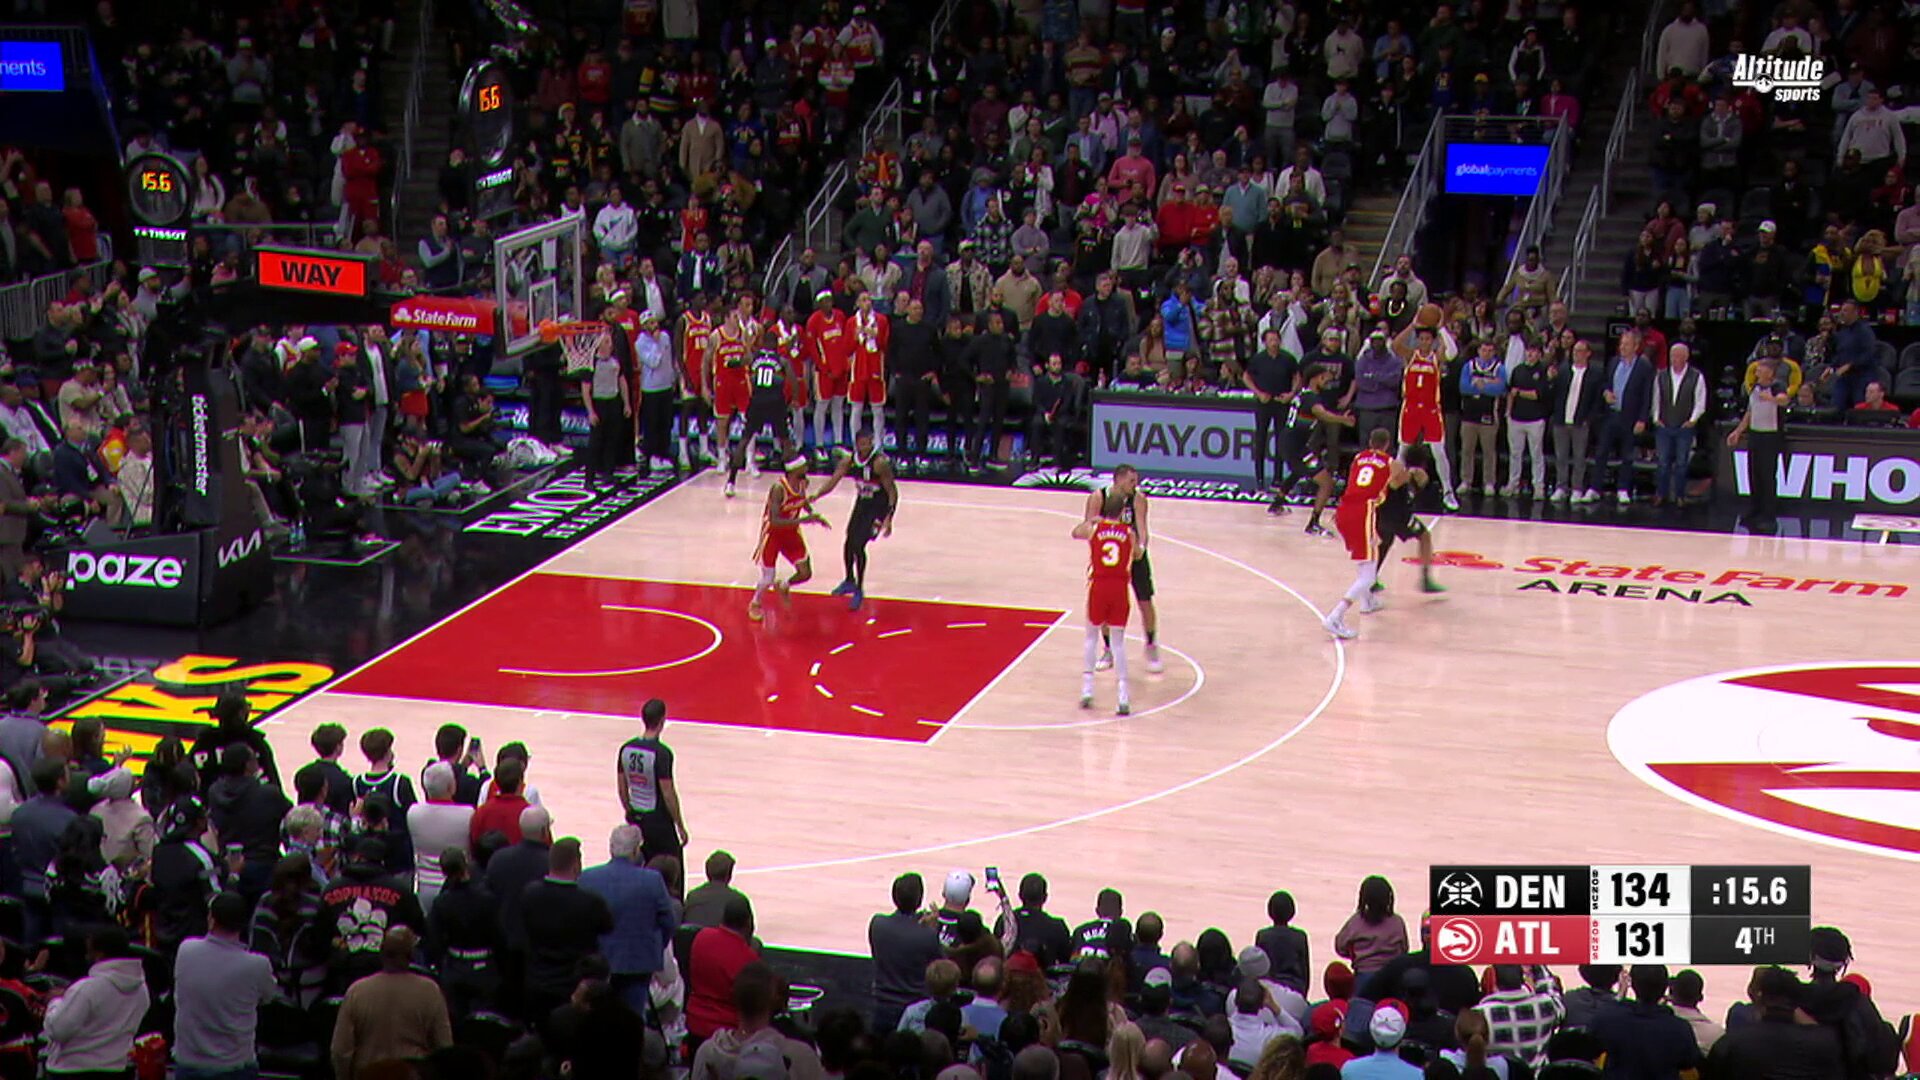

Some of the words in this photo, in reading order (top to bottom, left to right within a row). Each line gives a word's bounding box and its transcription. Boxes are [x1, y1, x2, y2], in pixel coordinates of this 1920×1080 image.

[281, 260, 343, 286] WAY
[757, 366, 773, 387] 10
[1416, 374, 1424, 388] 1
[1356, 466, 1375, 487] 8
[1101, 541, 1120, 567] 3
[66, 552, 184, 590] paze
[1516, 578, 1754, 607] ARENA
[629, 751, 645, 773] 35
